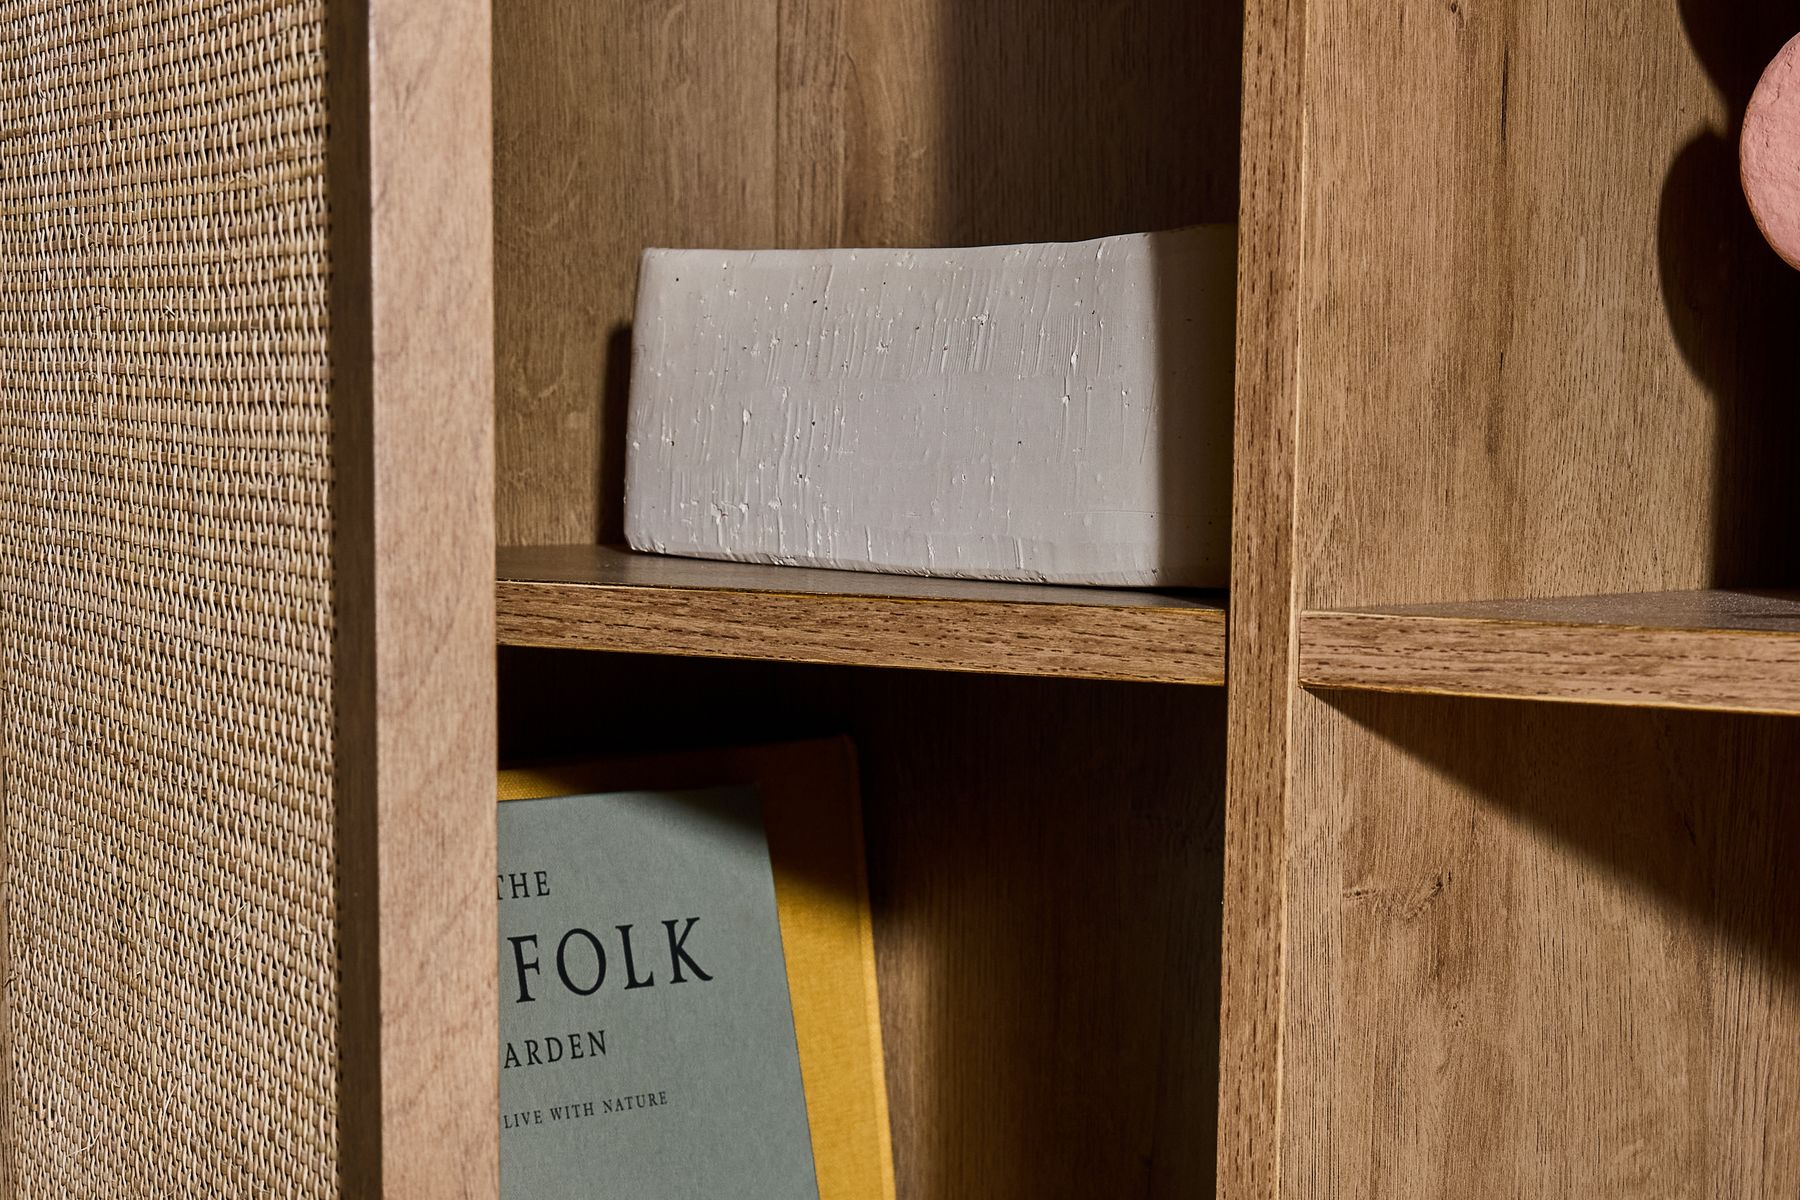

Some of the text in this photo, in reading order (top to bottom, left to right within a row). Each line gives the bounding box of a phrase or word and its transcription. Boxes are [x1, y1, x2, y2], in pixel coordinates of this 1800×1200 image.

[507, 917, 714, 1003] FOLK
[504, 1030, 607, 1068] ARDEN
[503, 1091, 668, 1128] LIVE WITH NATURE
